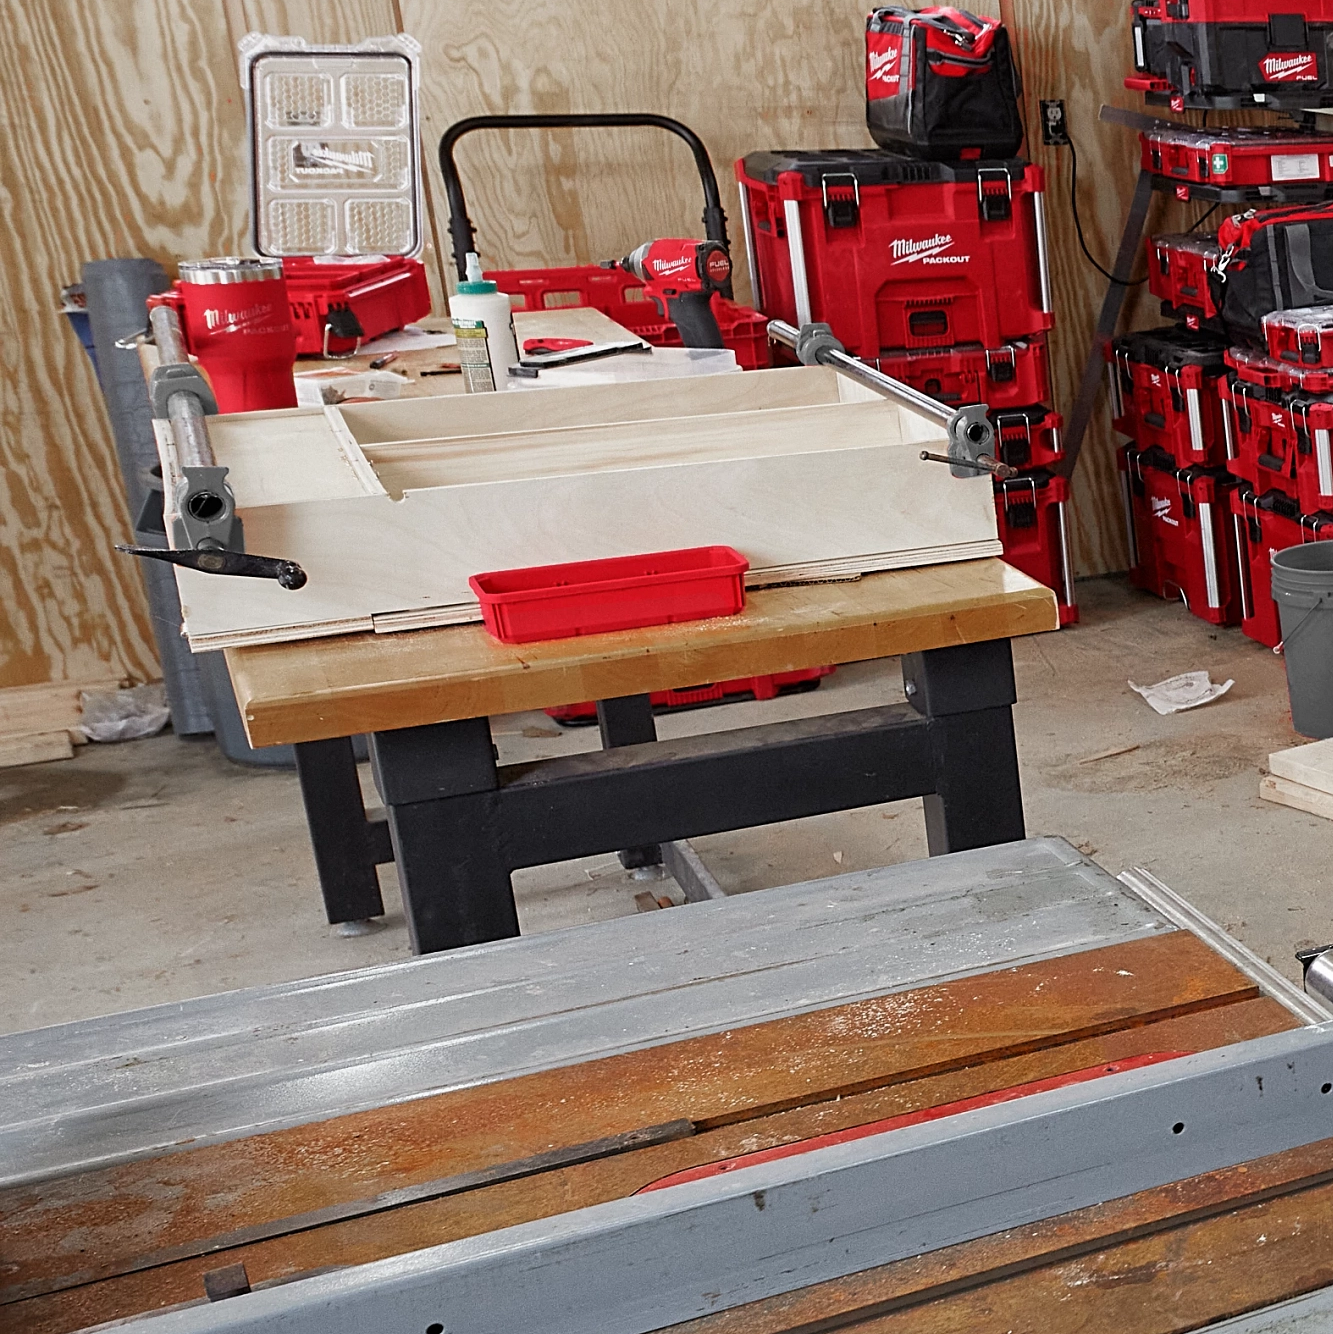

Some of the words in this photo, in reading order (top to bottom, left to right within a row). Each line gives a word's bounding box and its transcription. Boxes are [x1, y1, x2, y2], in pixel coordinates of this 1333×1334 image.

[1264, 55, 1312, 74] Milwaukee
[889, 233, 953, 259] Milwaukee
[653, 256, 692, 272] Milwaukee
[923, 255, 971, 265] PACKOUT
[204, 303, 273, 331] Milwaukee
